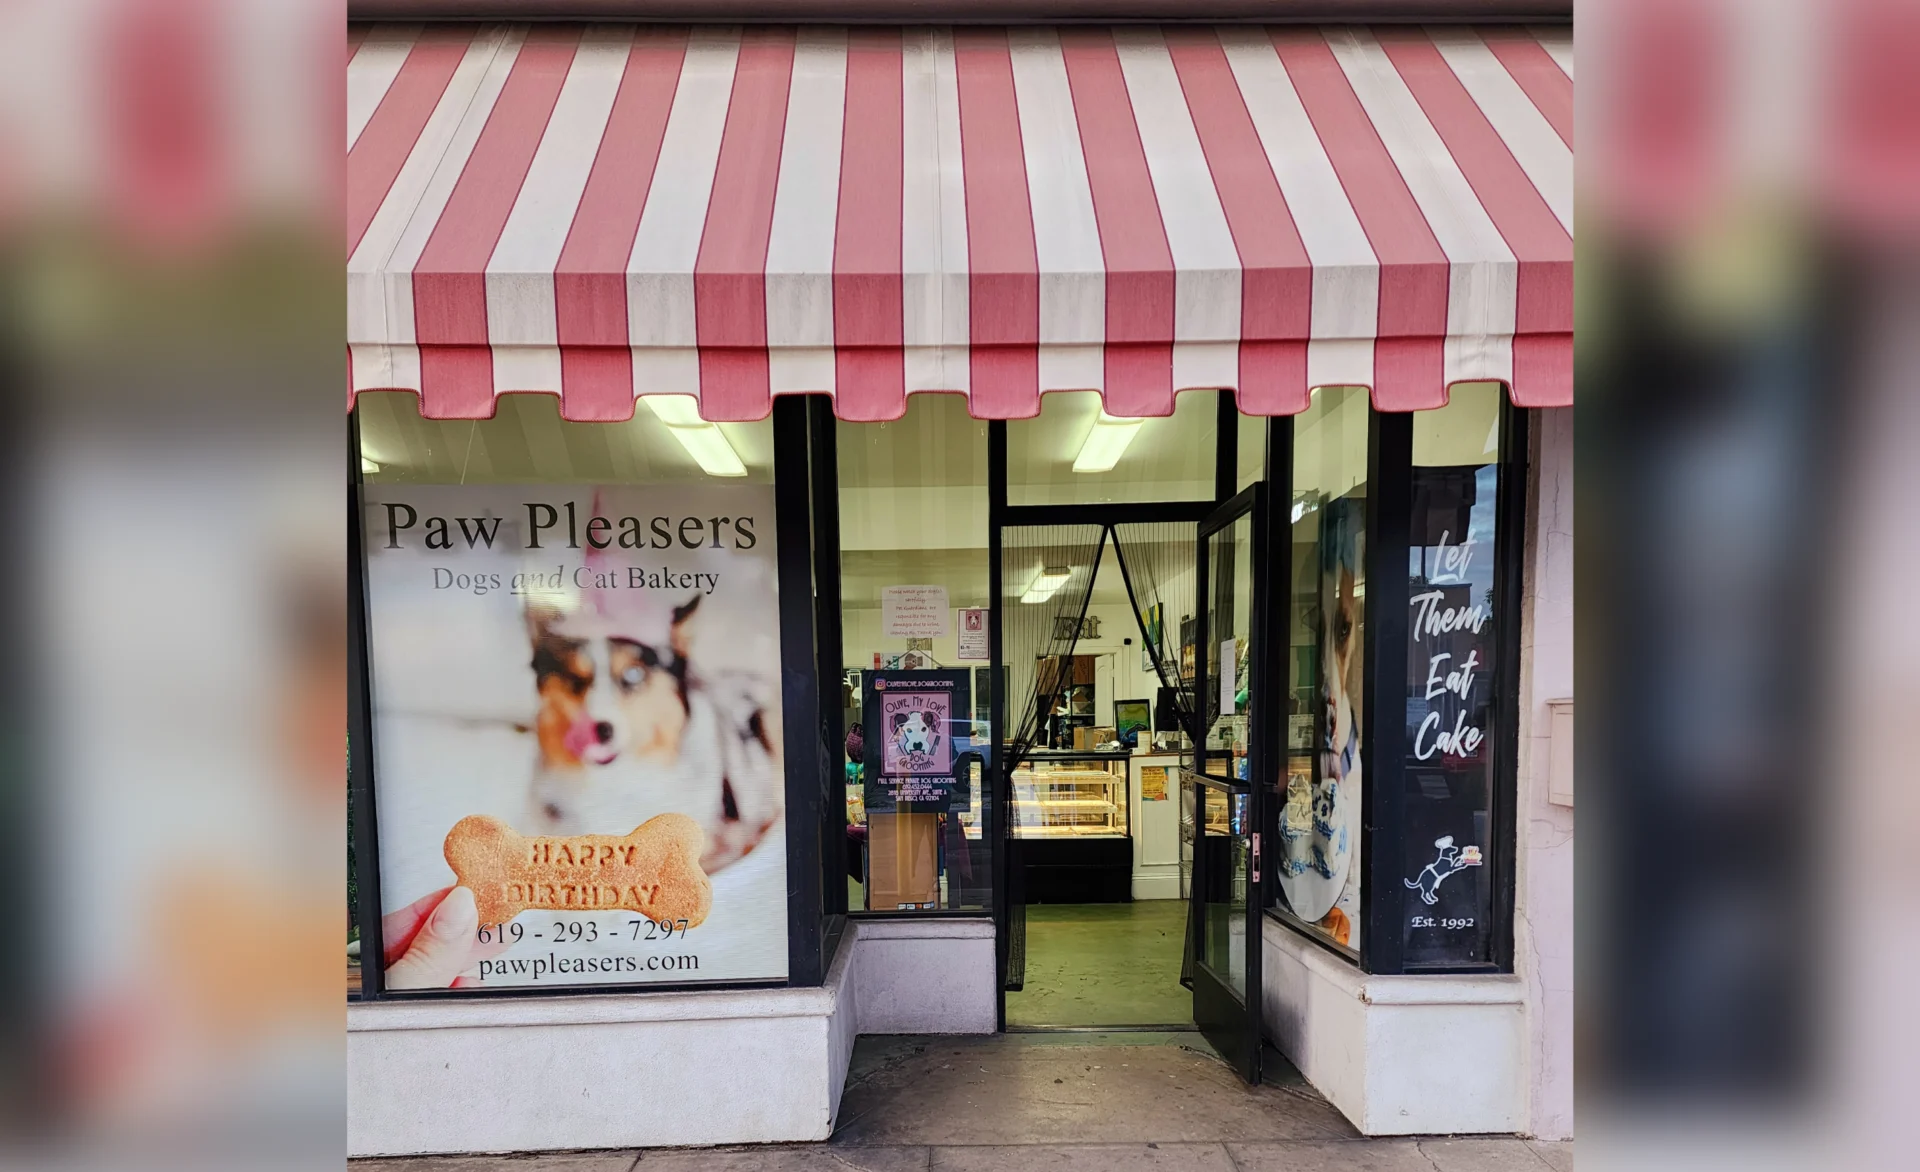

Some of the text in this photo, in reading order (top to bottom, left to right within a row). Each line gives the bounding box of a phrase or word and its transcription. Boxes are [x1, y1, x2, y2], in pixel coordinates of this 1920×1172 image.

[381, 501, 757, 550] Paw Pleasers
[1429, 528, 1478, 584] Let
[432, 565, 720, 595] Dogs and Cat Bakery
[1410, 589, 1487, 642] Them
[1425, 650, 1479, 700] Eat
[1414, 708, 1484, 761] Cake
[899, 757, 935, 771] GROOMING
[910, 753, 924, 762] DOG
[532, 843, 637, 867] HAPPY
[505, 882, 661, 906] BIRTHDAY
[477, 922, 524, 944] 619
[552, 921, 599, 943] 293
[628, 919, 689, 941] 7297
[1411, 916, 1474, 930] Est. 1992
[478, 952, 700, 981] pawpleasers.com
